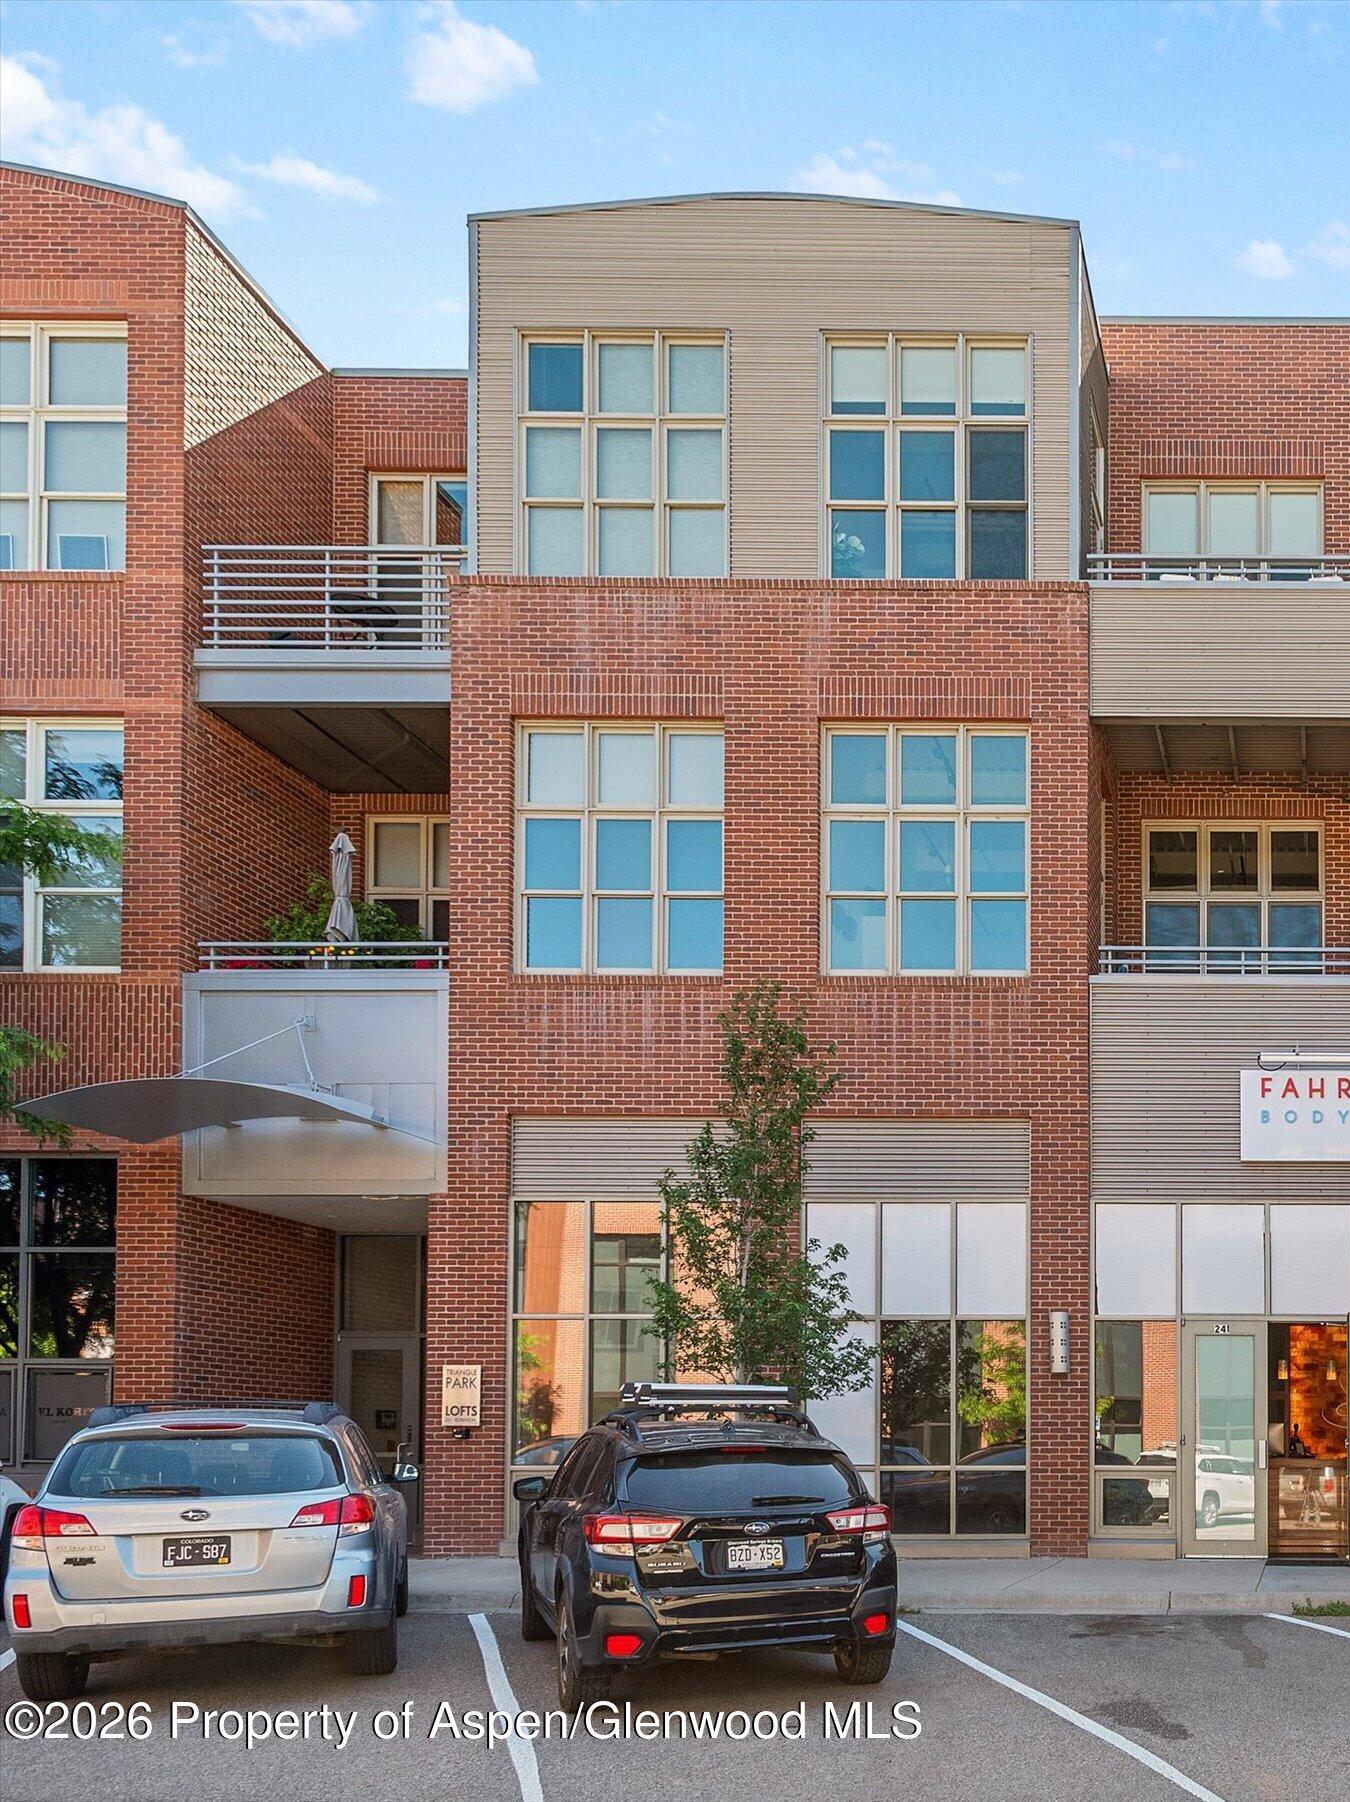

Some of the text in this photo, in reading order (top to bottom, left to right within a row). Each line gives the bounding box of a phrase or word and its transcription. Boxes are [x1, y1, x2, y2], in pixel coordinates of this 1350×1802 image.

[1261, 1109, 1349, 1124] BODY
[1214, 1325, 1230, 1333] 241
[446, 1377, 477, 1389] PARK
[445, 1405, 477, 1416] LOFTS
